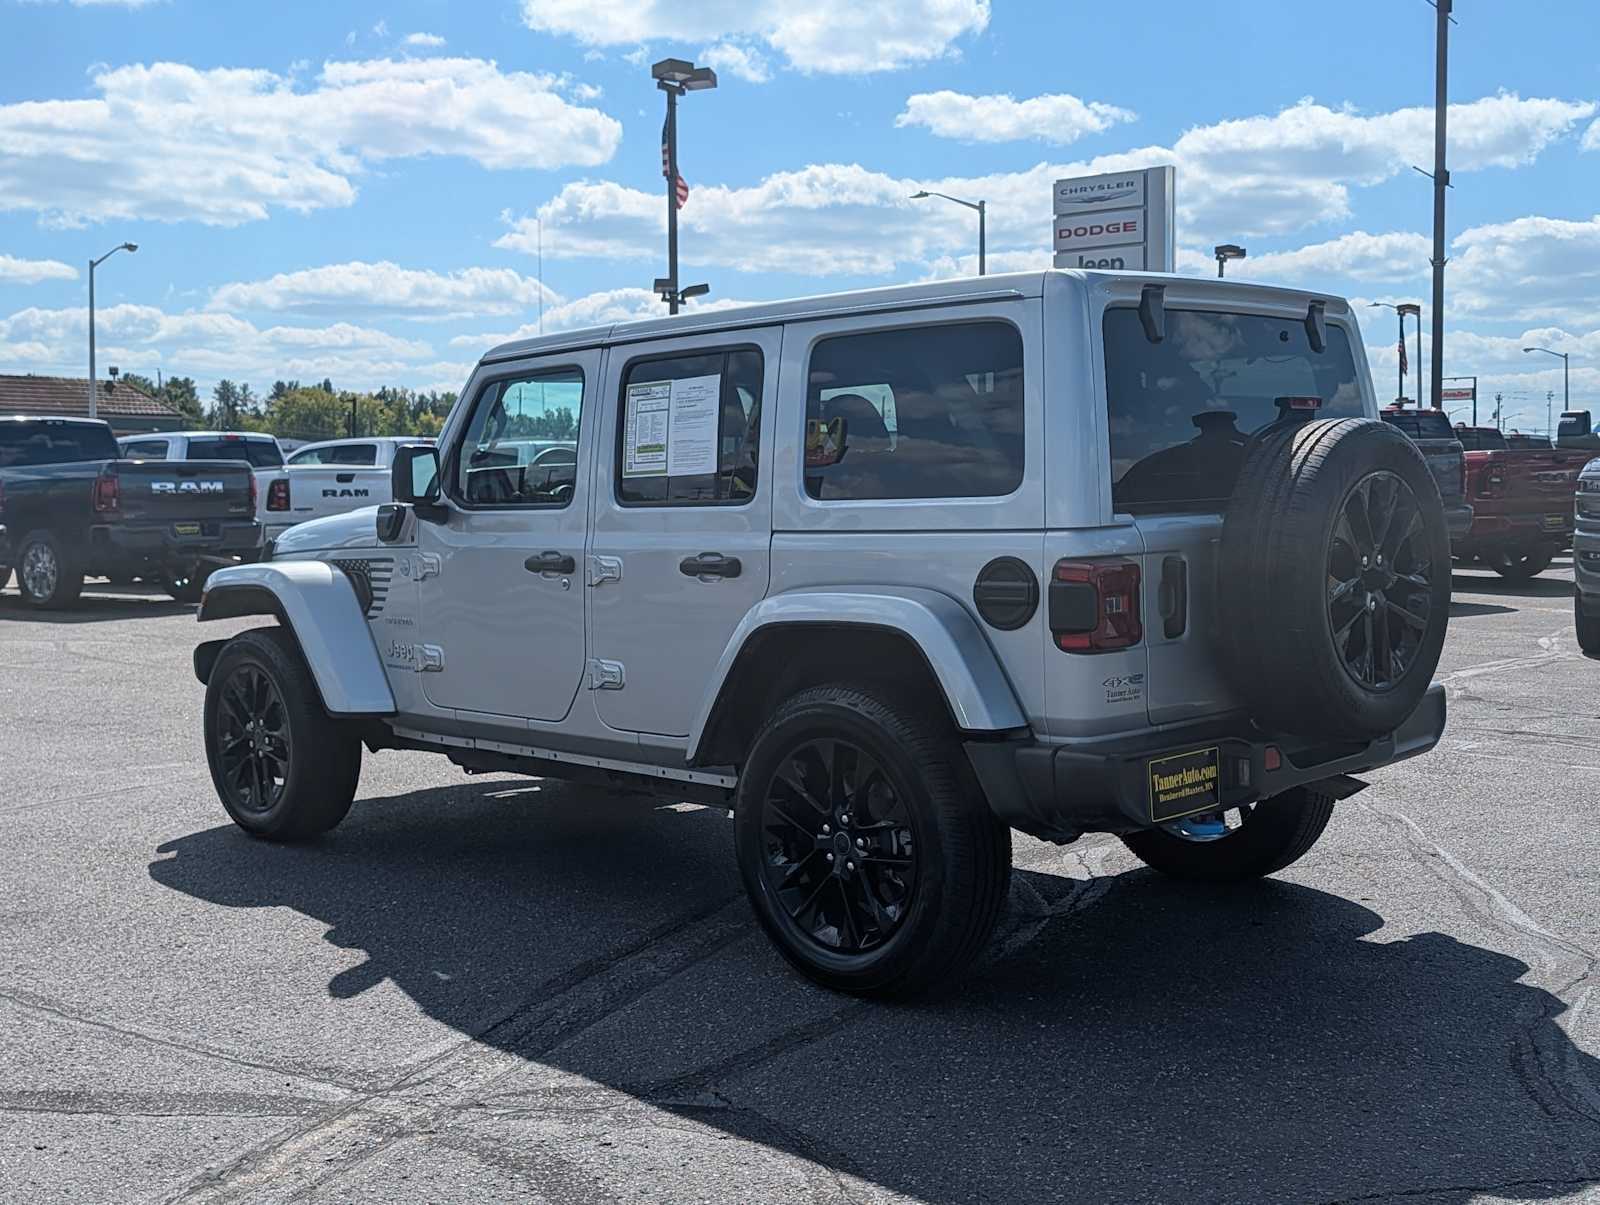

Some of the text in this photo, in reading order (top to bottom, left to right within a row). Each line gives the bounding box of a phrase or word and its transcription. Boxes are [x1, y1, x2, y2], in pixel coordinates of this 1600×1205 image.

[1060, 180, 1135, 196] CHRYSLER
[1058, 221, 1137, 239] DODGE
[151, 481, 224, 494] RAM
[322, 488, 369, 498] RAM
[1152, 765, 1217, 792] TannerAuto.com
